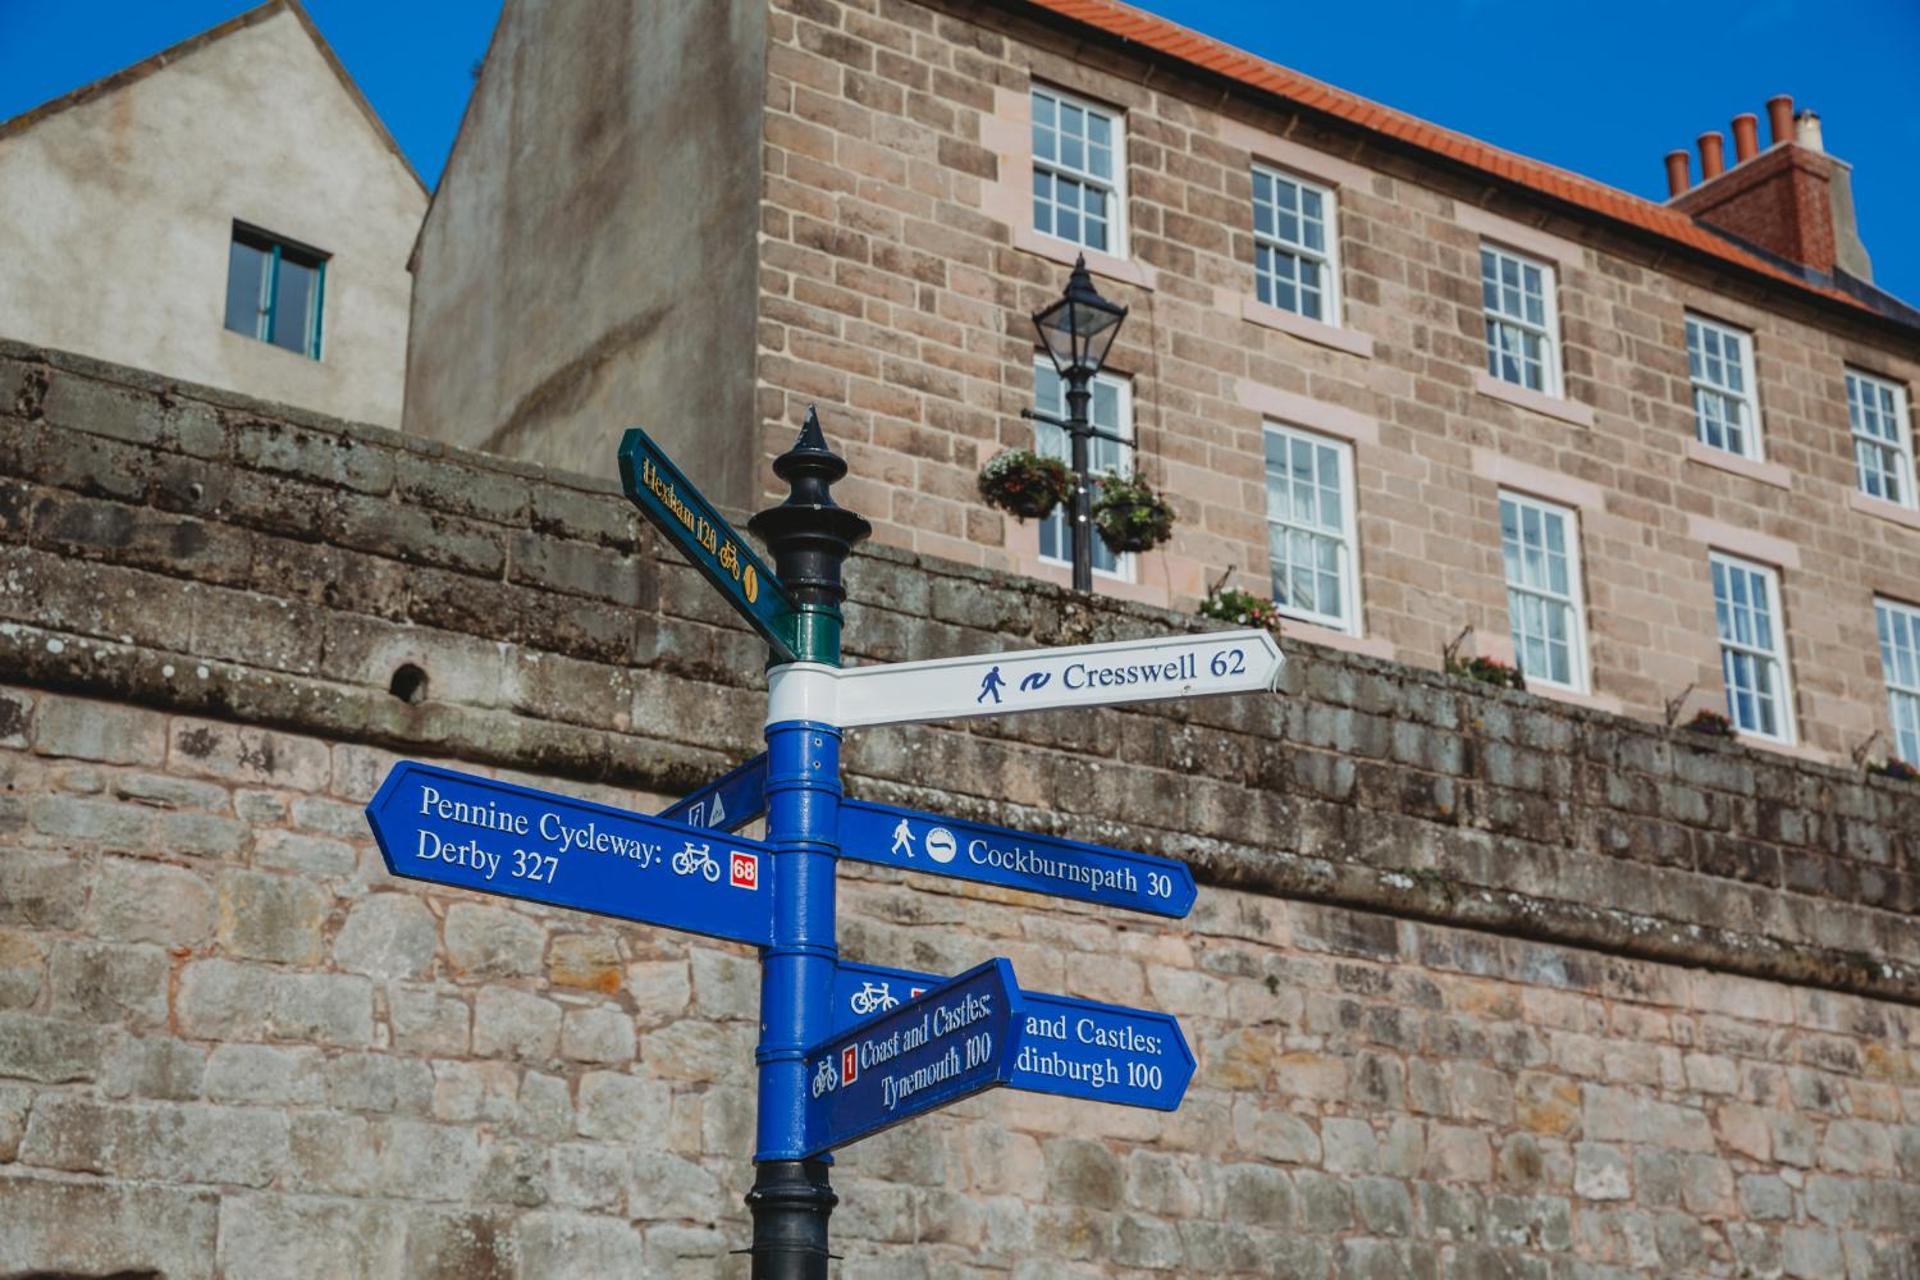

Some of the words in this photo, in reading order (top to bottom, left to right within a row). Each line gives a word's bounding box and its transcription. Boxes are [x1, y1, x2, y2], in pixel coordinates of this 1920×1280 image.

[643, 458, 695, 532] Hexham
[696, 517, 717, 555] 120
[1063, 653, 1197, 689] Cresswell
[1210, 649, 1246, 676] 62
[420, 786, 529, 836] Pennine
[539, 813, 662, 868] Cycleway:
[416, 829, 501, 879] Derby
[511, 850, 559, 884] 327
[734, 859, 755, 880] 68
[968, 839, 1138, 892] Cockburnspath
[1147, 872, 1172, 898] 30
[861, 1032, 901, 1070] Coast
[903, 1013, 929, 1046] and
[932, 993, 992, 1037] Castles:
[1026, 1016, 1066, 1039] and
[1077, 1018, 1162, 1055] Castles:
[881, 1045, 961, 1110] Tynemouth
[965, 1031, 992, 1070] 100
[1014, 1046, 1119, 1088] dinburgh
[1127, 1062, 1162, 1090] 100
